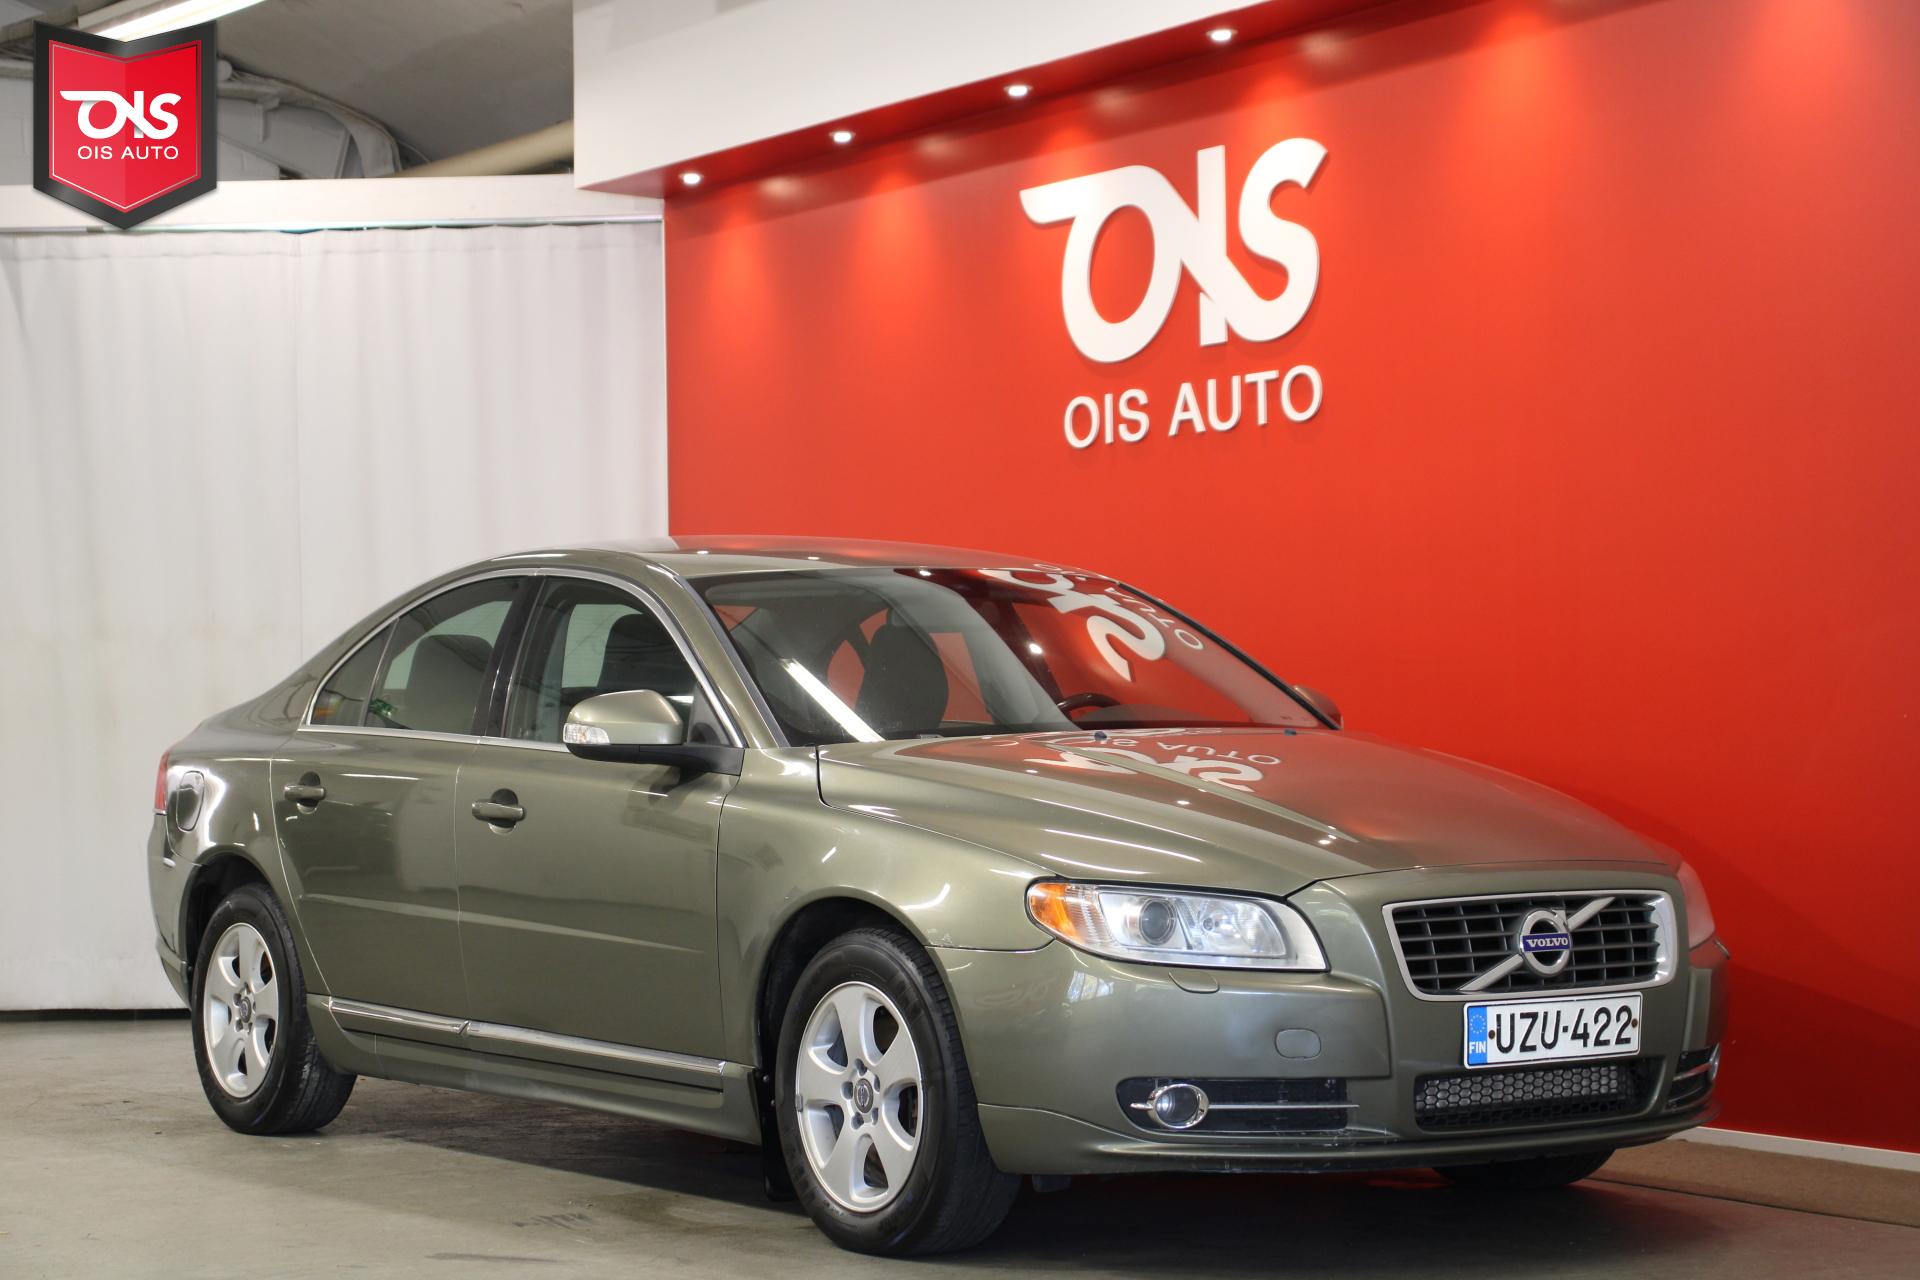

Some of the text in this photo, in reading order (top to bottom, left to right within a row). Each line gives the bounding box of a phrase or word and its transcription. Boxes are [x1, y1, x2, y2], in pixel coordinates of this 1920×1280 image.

[1019, 137, 1328, 363] OIS
[1063, 365, 1323, 449] OIS AUTO
[1526, 937, 1569, 948] VOLVO
[1469, 1041, 1486, 1054] FIN
[1496, 1005, 1632, 1054] UZU-422
